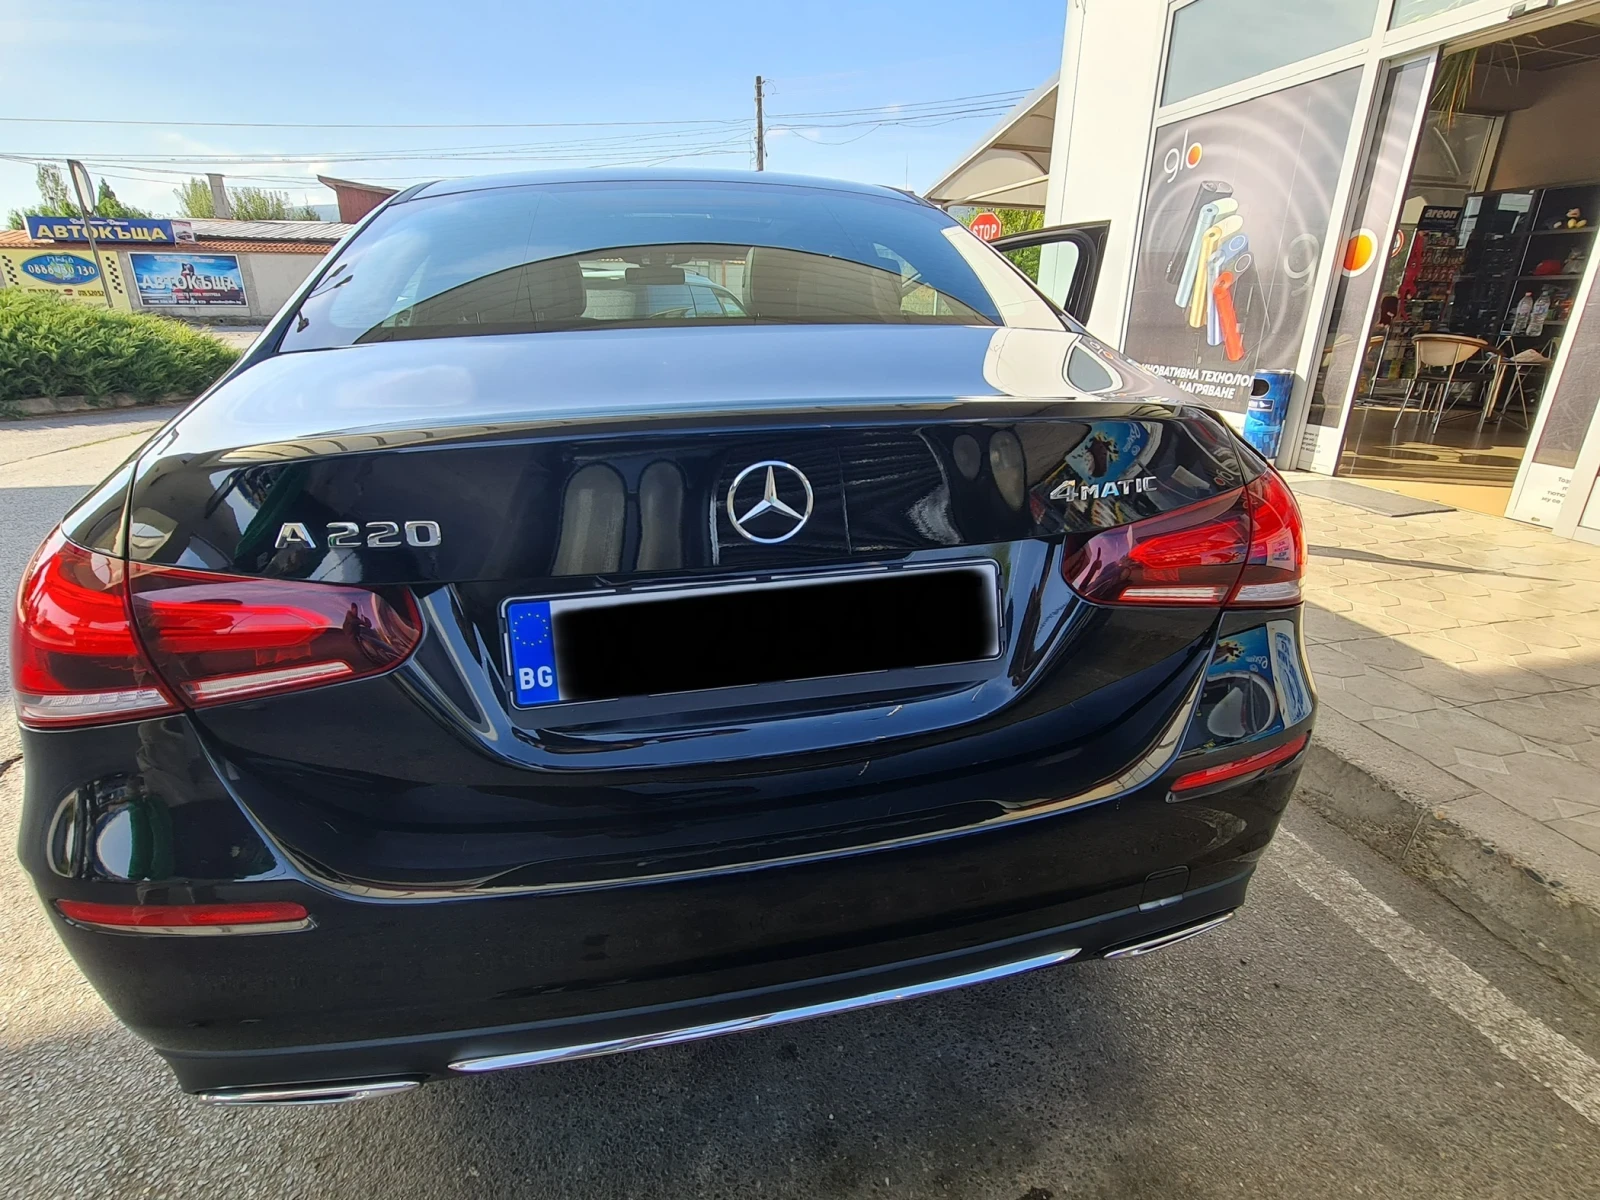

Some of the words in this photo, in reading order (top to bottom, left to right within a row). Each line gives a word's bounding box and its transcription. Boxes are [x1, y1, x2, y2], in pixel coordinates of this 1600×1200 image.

[1163, 129, 1203, 183] glo
[1425, 208, 1460, 219] areon
[37, 225, 167, 241] АВТОКЪЩА
[972, 224, 997, 240] STOP
[142, 275, 239, 292] АВТОКЪЩА
[1179, 380, 1235, 399] НАГРЯВАНЕ
[1050, 476, 1157, 502] 4MATIC
[274, 522, 316, 549] A
[326, 520, 441, 548] 220
[518, 665, 553, 690] BG
